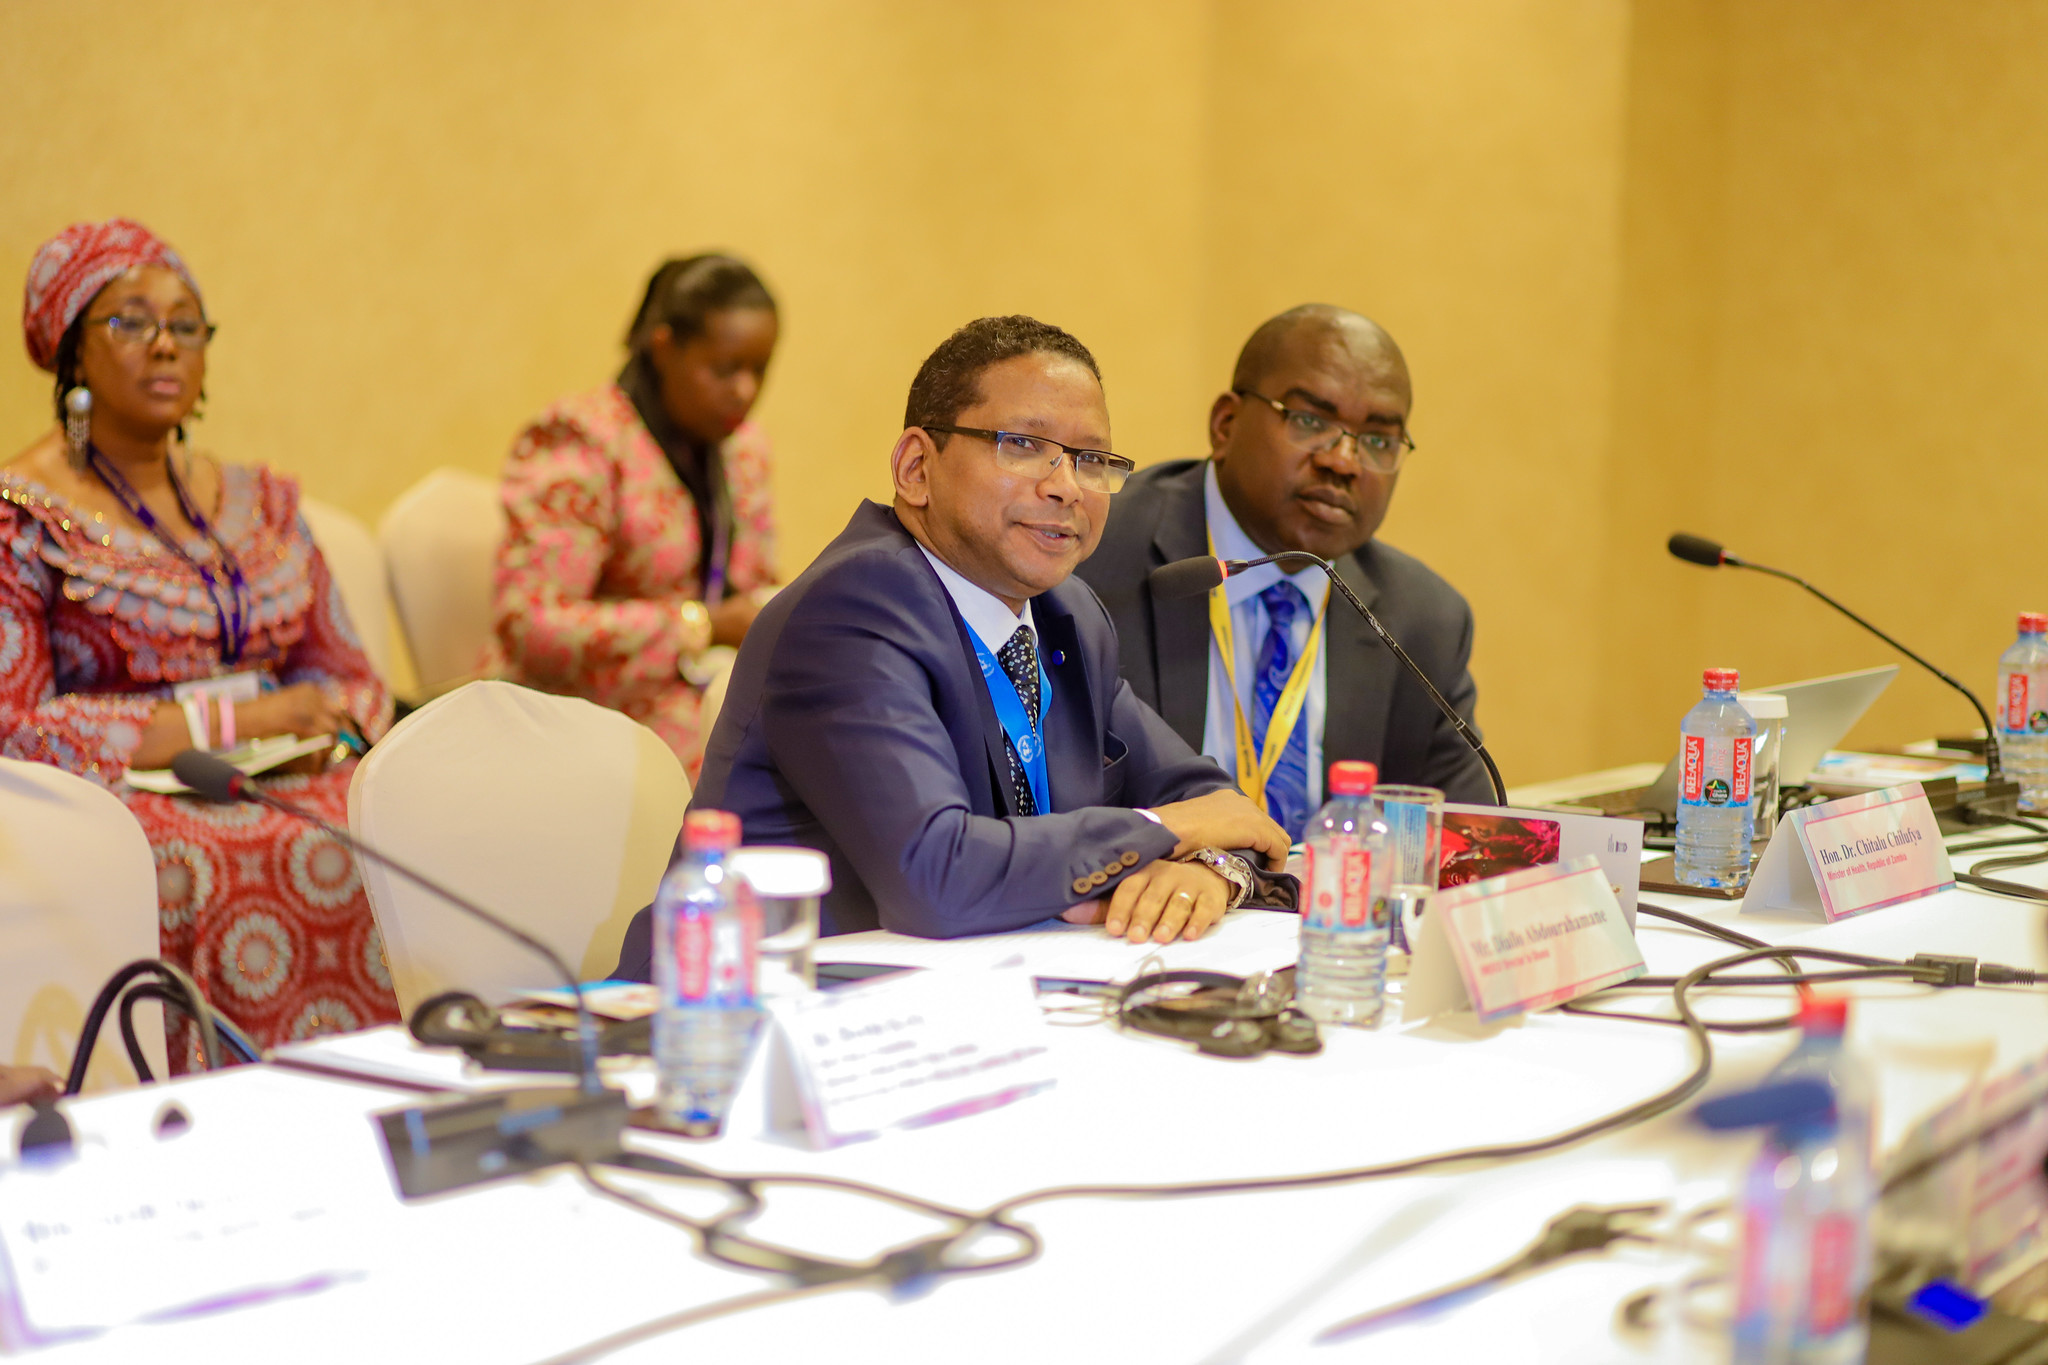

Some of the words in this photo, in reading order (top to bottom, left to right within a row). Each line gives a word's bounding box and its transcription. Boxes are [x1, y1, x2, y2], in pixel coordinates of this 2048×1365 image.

[1686, 739, 1700, 793] BEL-AQUA
[1736, 741, 1749, 795] BEL-AQUA
[1820, 849, 1842, 865] Hon.
[1841, 844, 1856, 860] Dr.
[1856, 835, 1887, 855] Chitalu
[1887, 827, 1922, 846] Chilufya
[1827, 870, 1845, 880] Minister
